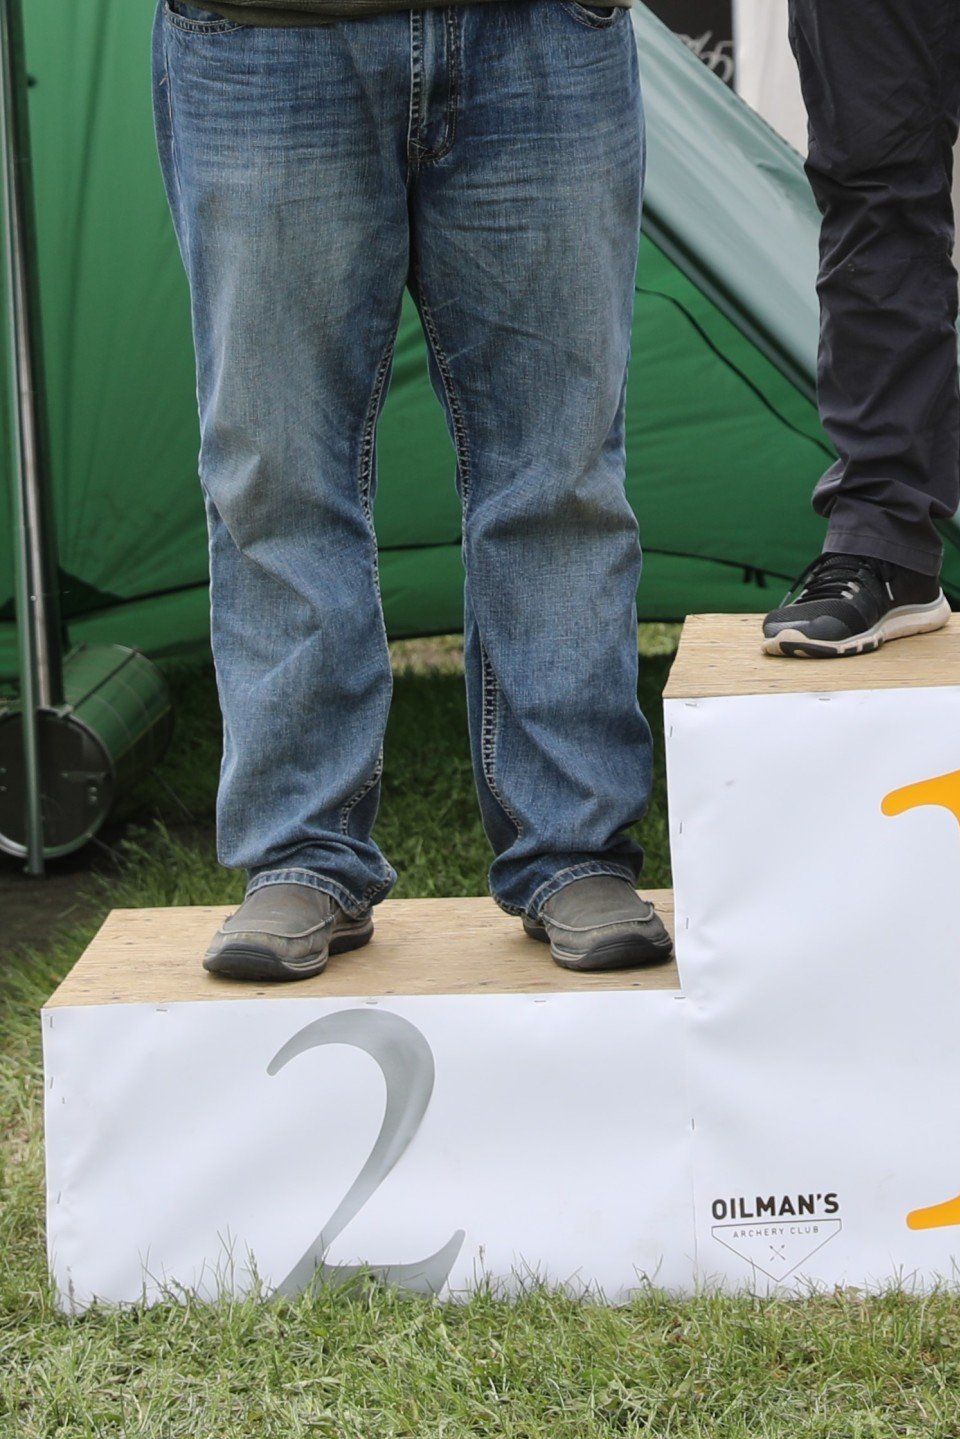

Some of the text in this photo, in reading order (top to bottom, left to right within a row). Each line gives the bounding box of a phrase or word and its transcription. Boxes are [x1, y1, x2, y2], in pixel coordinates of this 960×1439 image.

[265, 1007, 466, 1304] 2
[711, 1192, 840, 1221] OILMAN'S
[732, 1225, 820, 1239] ARCHERY CLUB
